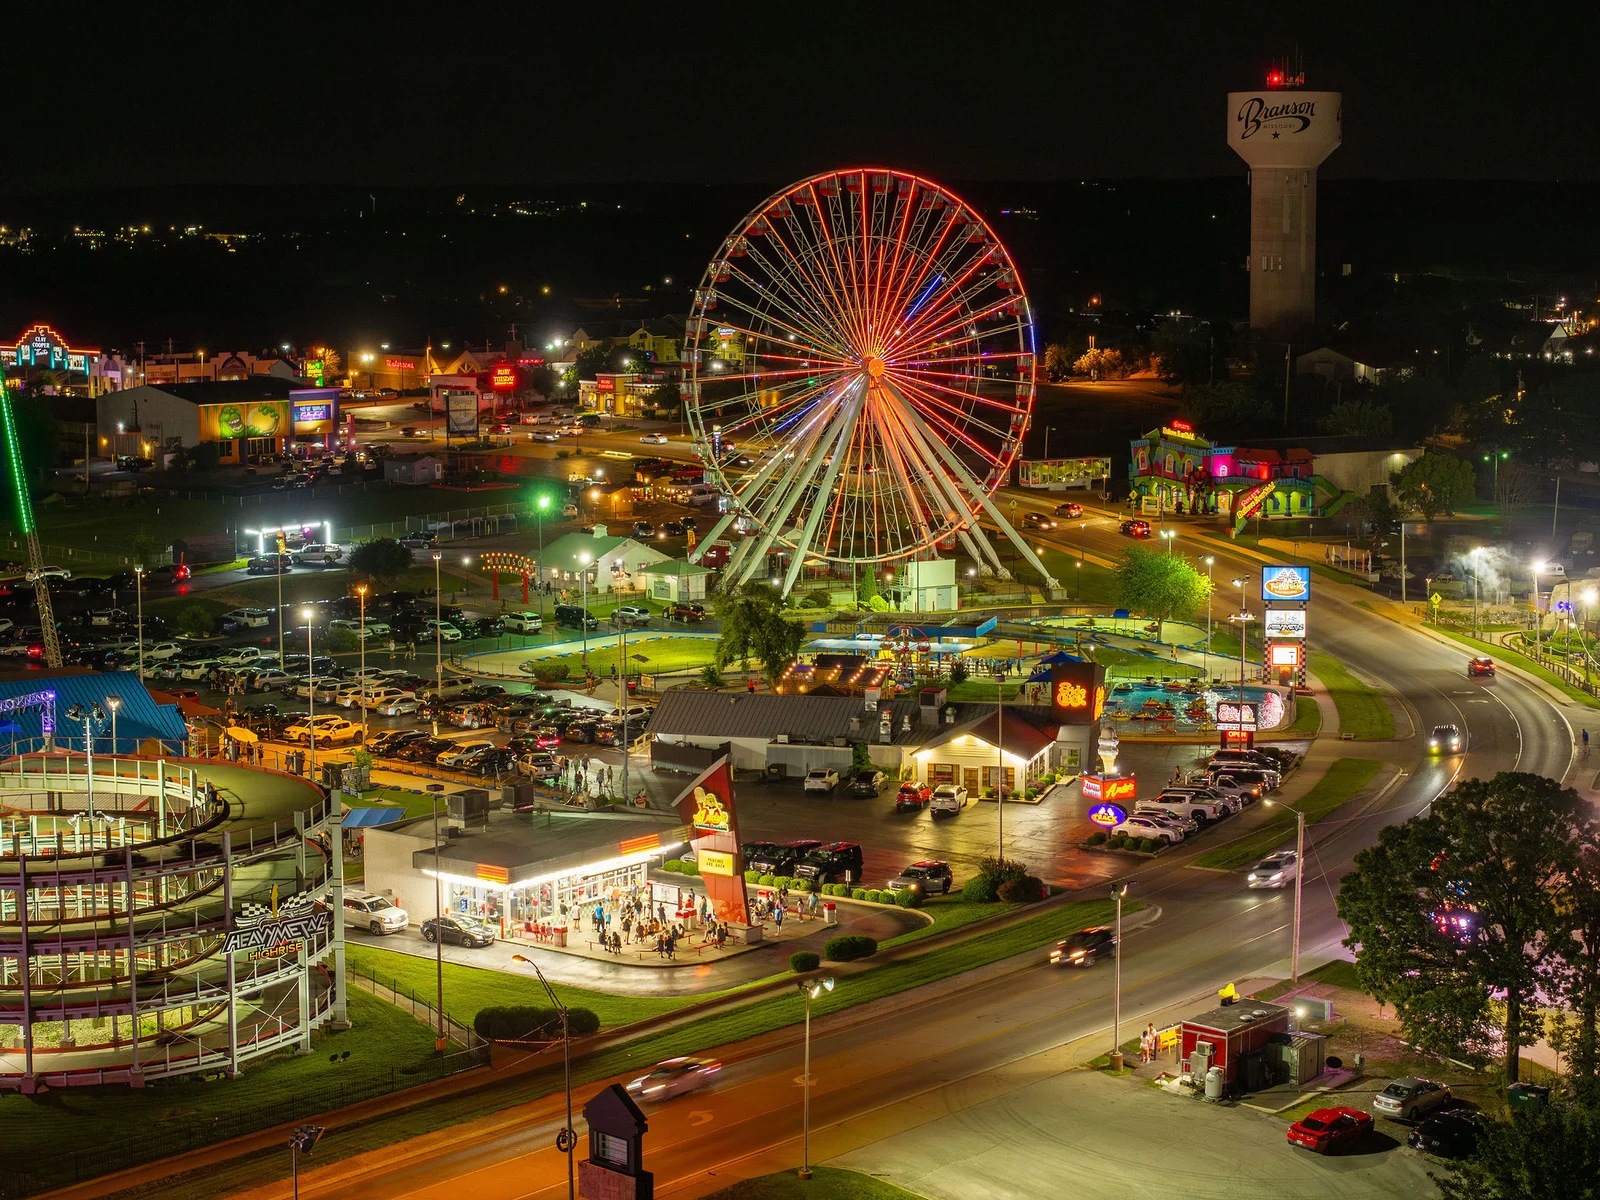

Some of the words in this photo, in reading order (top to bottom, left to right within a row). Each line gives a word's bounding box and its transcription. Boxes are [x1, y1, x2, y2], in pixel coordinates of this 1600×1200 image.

[1238, 97, 1316, 140] Branson
[490, 557, 527, 568] BRANSON
[826, 623, 860, 634] CLASSIC
[862, 624, 889, 635] TRACK
[1105, 783, 1134, 798] Andy's
[693, 809, 728, 825] Andy's
[249, 942, 303, 961] HIGHRISE
